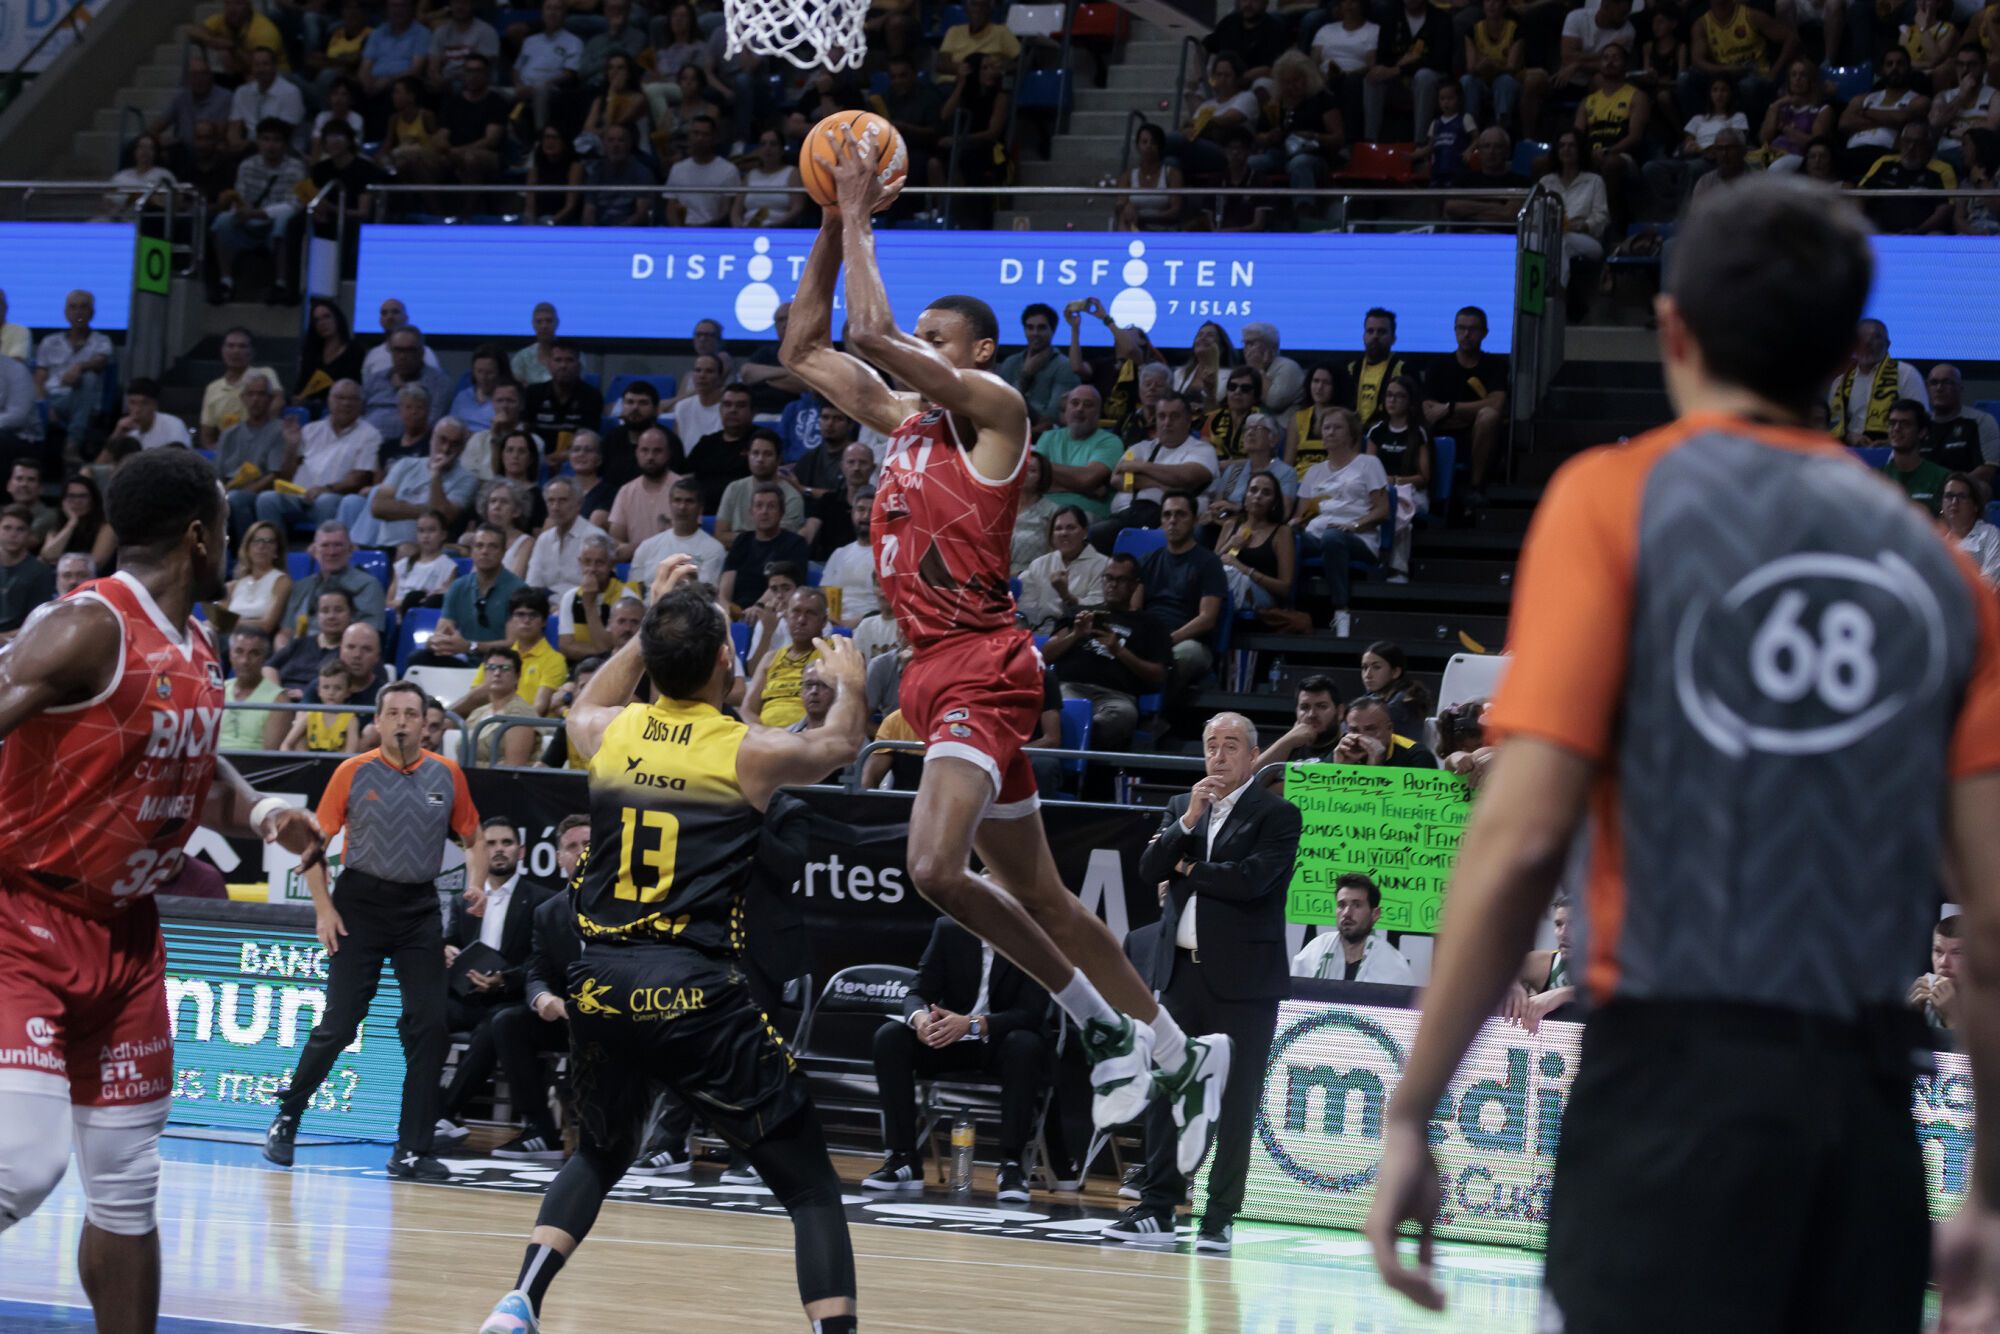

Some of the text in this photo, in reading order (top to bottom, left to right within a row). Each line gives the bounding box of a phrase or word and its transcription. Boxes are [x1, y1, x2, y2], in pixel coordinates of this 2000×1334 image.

[1168, 300, 1252, 316] 7 ISLAS
[1750, 588, 1878, 714] 68
[1403, 772, 1476, 802] Aurineg
[1300, 824, 1343, 838] OMOS
[1346, 825, 1376, 840] UNA
[614, 806, 680, 904] 13
[791, 854, 905, 903] rtes
[630, 987, 707, 1013] CICAR
[834, 978, 911, 998] tenerife
[101, 1060, 143, 1083] ETL
[102, 1078, 168, 1100] GLOBAL
